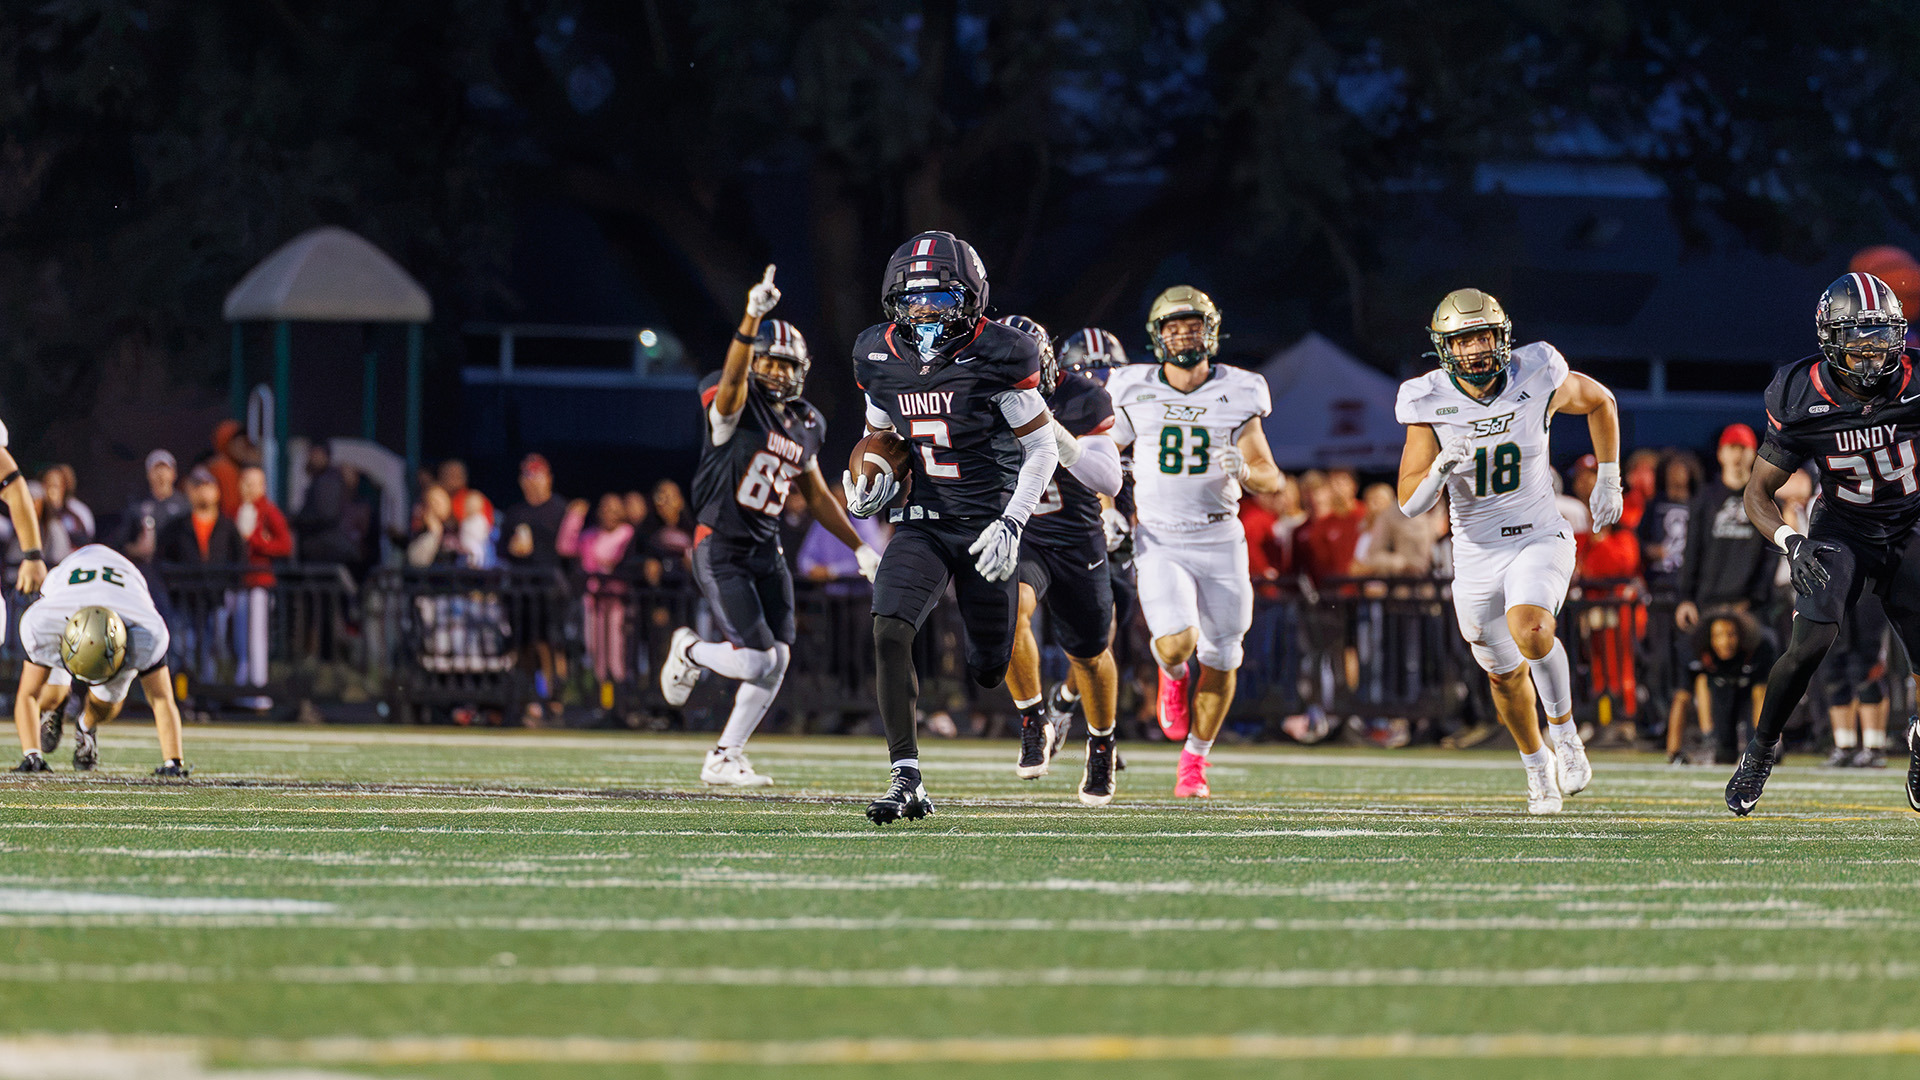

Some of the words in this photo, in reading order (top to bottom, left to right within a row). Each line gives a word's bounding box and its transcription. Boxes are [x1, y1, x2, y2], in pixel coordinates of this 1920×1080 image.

[897, 391, 955, 416] UINDY
[1161, 403, 1207, 422] S&T
[1467, 411, 1515, 438] S&T
[1835, 424, 1897, 452] UINDY
[767, 431, 804, 464] UINDY
[910, 418, 961, 479] 2
[1158, 426, 1211, 476] 83
[1472, 441, 1522, 497] 18
[1826, 439, 1919, 505] 34
